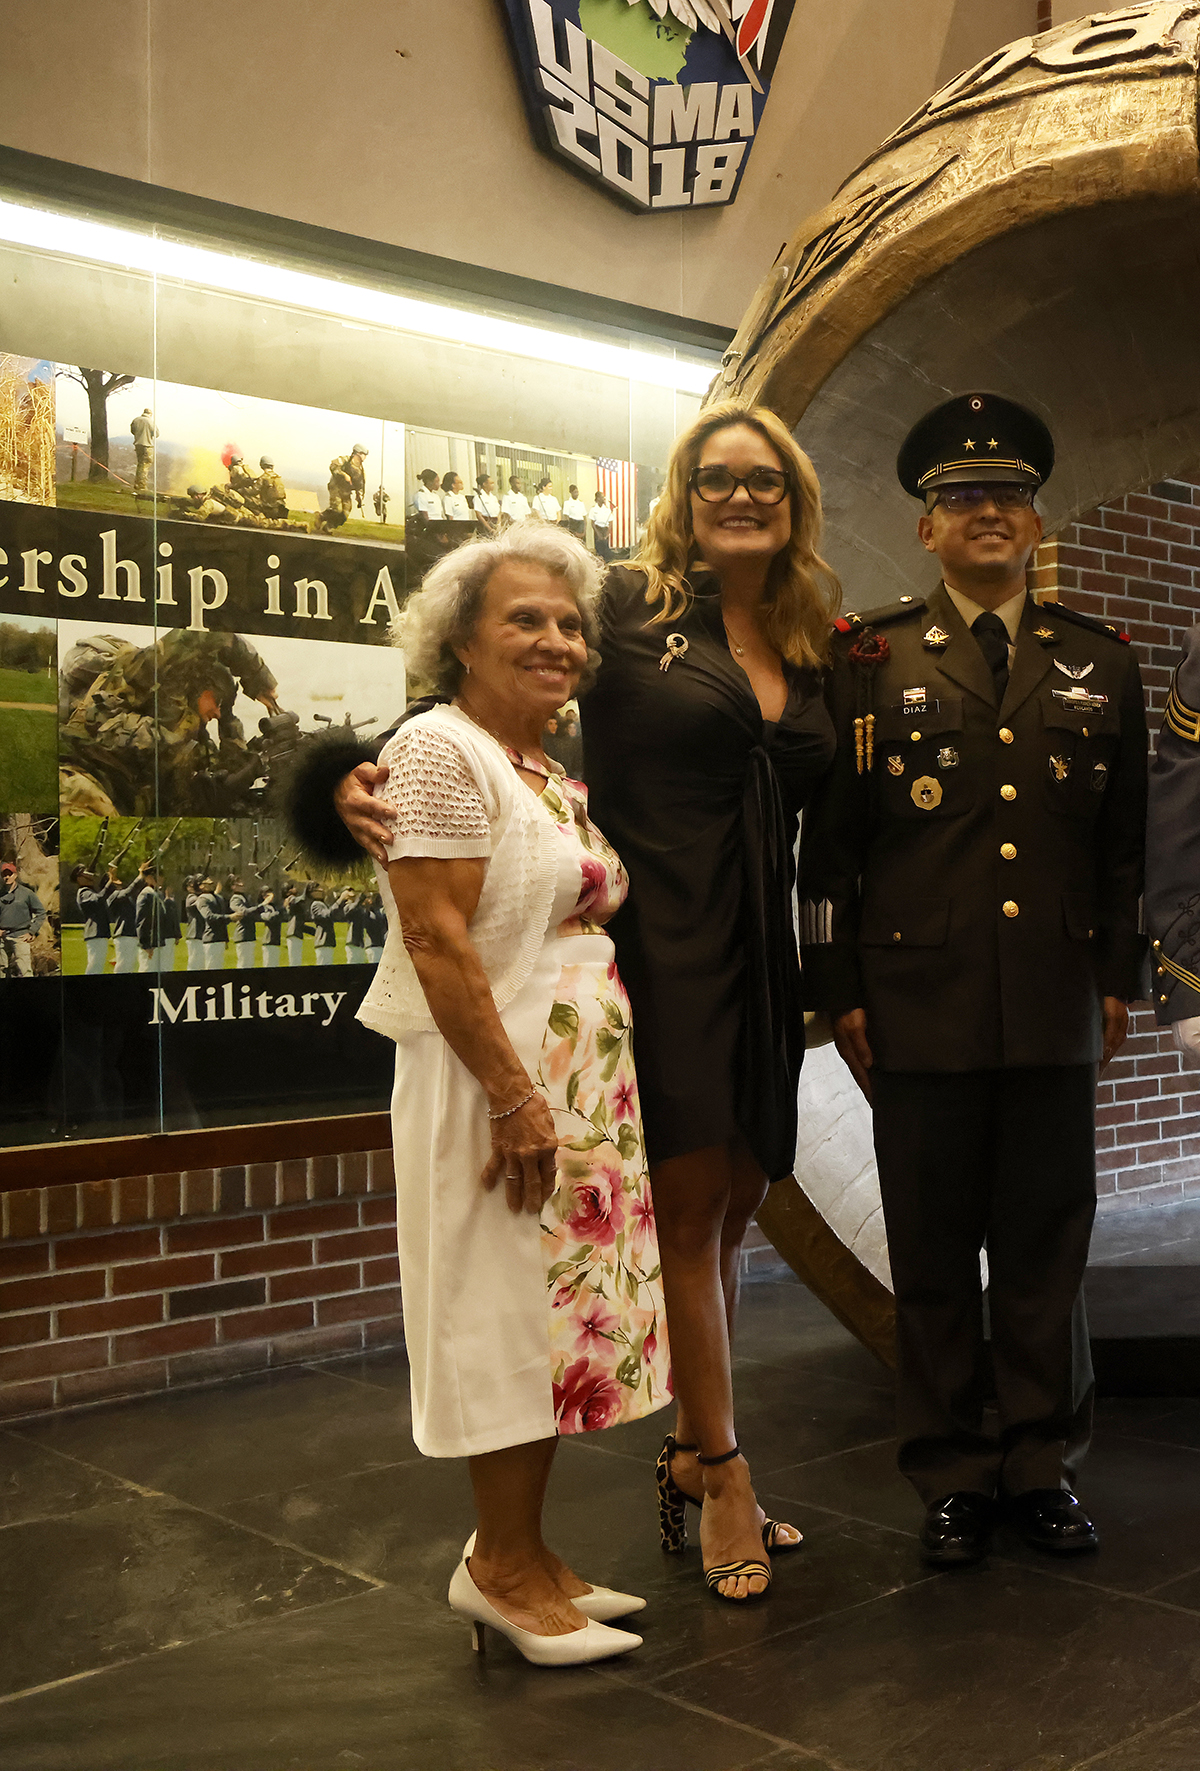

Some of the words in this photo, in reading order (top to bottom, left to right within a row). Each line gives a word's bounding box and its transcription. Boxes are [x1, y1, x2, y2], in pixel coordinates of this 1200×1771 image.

[529, 0, 755, 146] USMA
[538, 66, 748, 208] 2018
[264, 554, 333, 621] in
[903, 704, 927, 715] DIAZ
[148, 981, 348, 1026] Military
